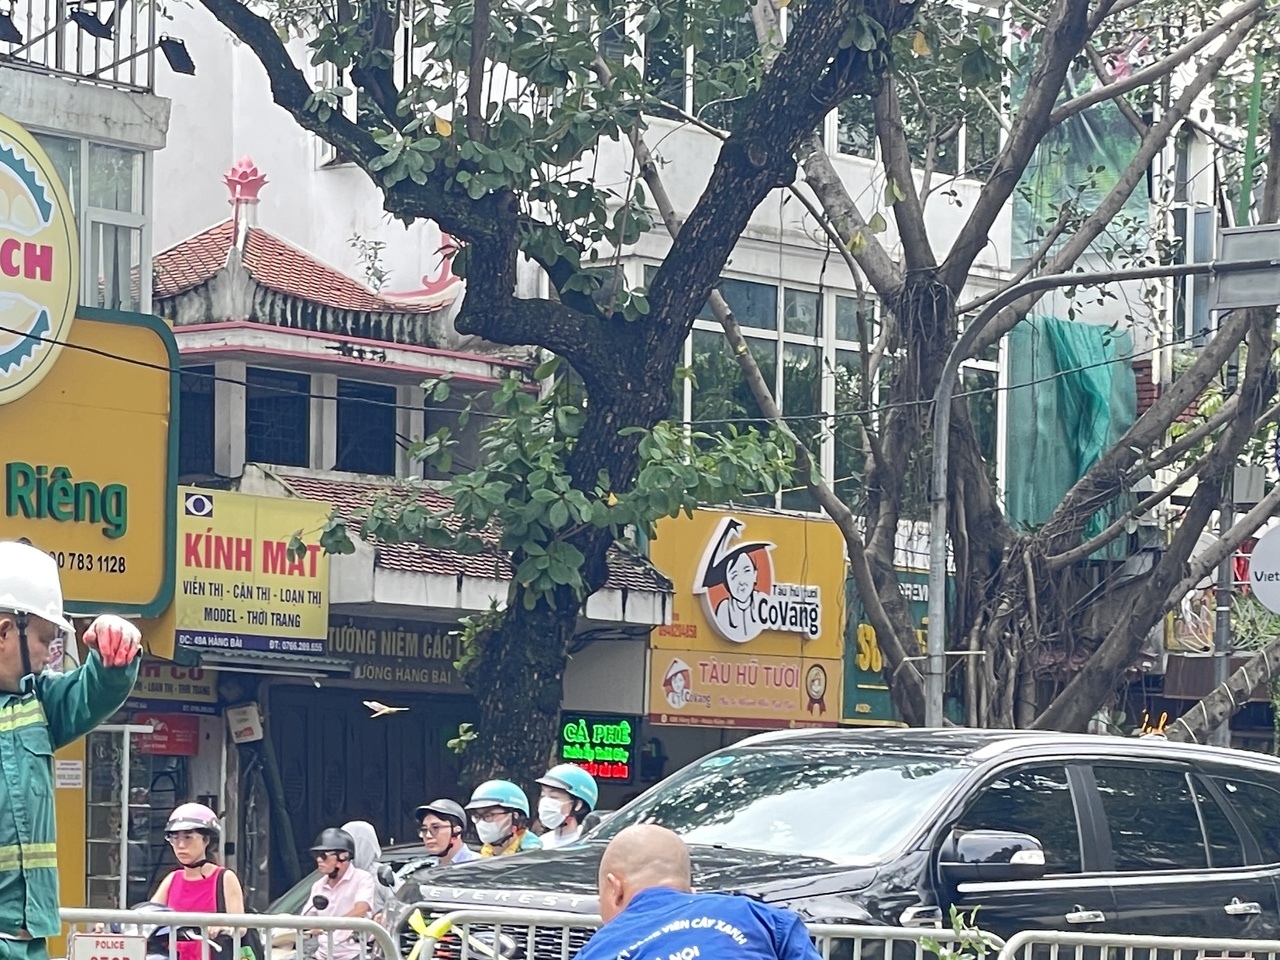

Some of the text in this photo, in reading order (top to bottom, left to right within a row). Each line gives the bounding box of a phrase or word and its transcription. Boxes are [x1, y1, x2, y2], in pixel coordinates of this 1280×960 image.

[6, 461, 128, 540] Riêng
[69, 552, 93, 571] 783
[97, 555, 126, 574] 1128
[185, 527, 252, 572] KÍNH
[209, 581, 224, 601] THỊ
[233, 581, 253, 602] CẬN
[256, 586, 271, 604] THỊ
[280, 588, 305, 606] LOẠN
[307, 590, 322, 608] THỊ
[204, 607, 301, 628] MODEL THỜI TRANG
[328, 617, 376, 655] TƯỞNG
[381, 626, 418, 663] NIỆM
[423, 629, 451, 659] CÁC
[699, 656, 731, 685] TÀU
[764, 663, 800, 689] TƯƠI
[592, 720, 631, 745] PHÊ
[430, 887, 585, 907] EVEREST
[95, 940, 125, 950] POLICE
[714, 919, 748, 946] XANH
